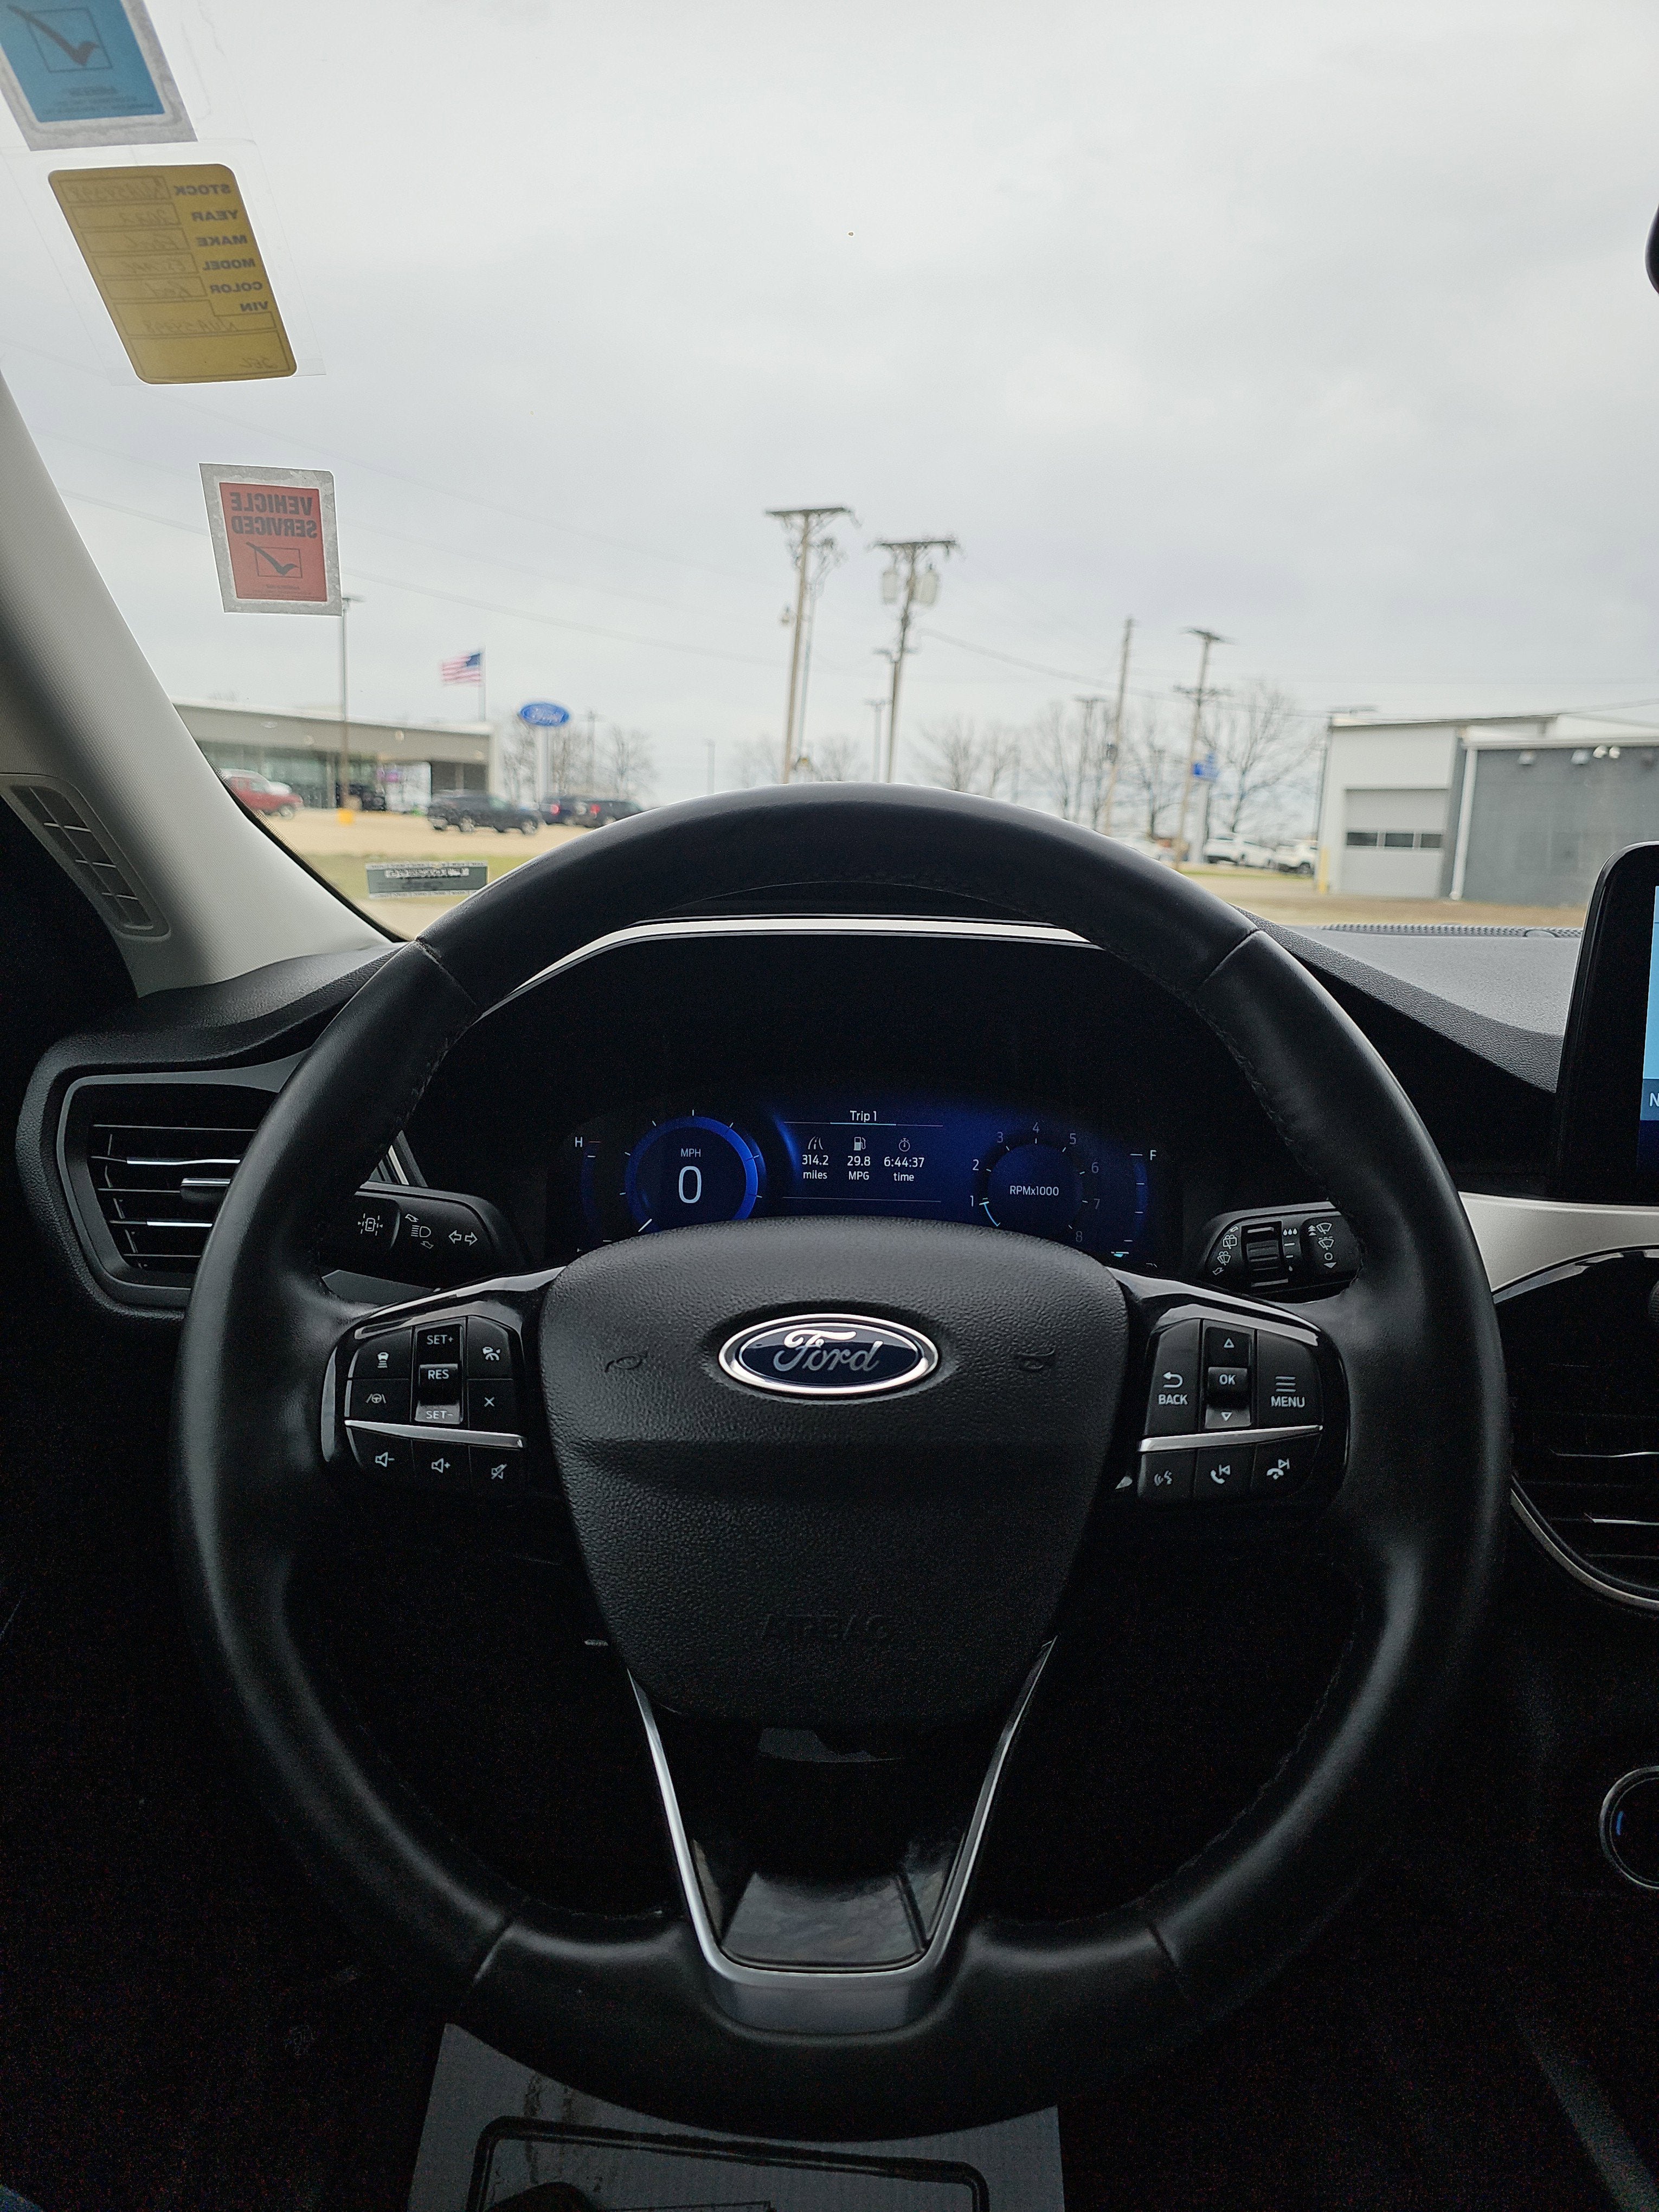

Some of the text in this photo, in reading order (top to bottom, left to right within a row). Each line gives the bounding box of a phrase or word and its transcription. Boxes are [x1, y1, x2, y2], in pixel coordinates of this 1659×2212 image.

[850, 1110, 877, 1123] Trip 1
[1032, 1122, 1040, 1134] 4
[575, 1136, 583, 1147] H
[996, 1131, 1004, 1143] 3
[1070, 1133, 1076, 1145] 5
[680, 1148, 701, 1158] MPH
[1150, 1149, 1157, 1161] F
[801, 1154, 829, 1166] 314.2
[847, 1155, 871, 1166] 29.8
[884, 1156, 925, 1168] 6:44:37
[972, 1159, 979, 1171] 2
[1091, 1161, 1099, 1174] 6
[803, 1170, 828, 1180] miles
[848, 1171, 870, 1180] MPG
[893, 1172, 915, 1182] time
[678, 1166, 702, 1204] 0
[1009, 1185, 1059, 1197] RPMx1000
[970, 1195, 974, 1207] 1
[1094, 1198, 1101, 1210] 7
[1076, 1231, 1083, 1243] 8
[426, 1334, 454, 1345] SET+
[773, 1329, 884, 1372] Ford
[428, 1369, 449, 1380] RES
[1219, 1374, 1236, 1385] OK
[1158, 1394, 1188, 1405] BACK
[1271, 1396, 1306, 1408] MENU
[426, 1410, 454, 1420] SET-
